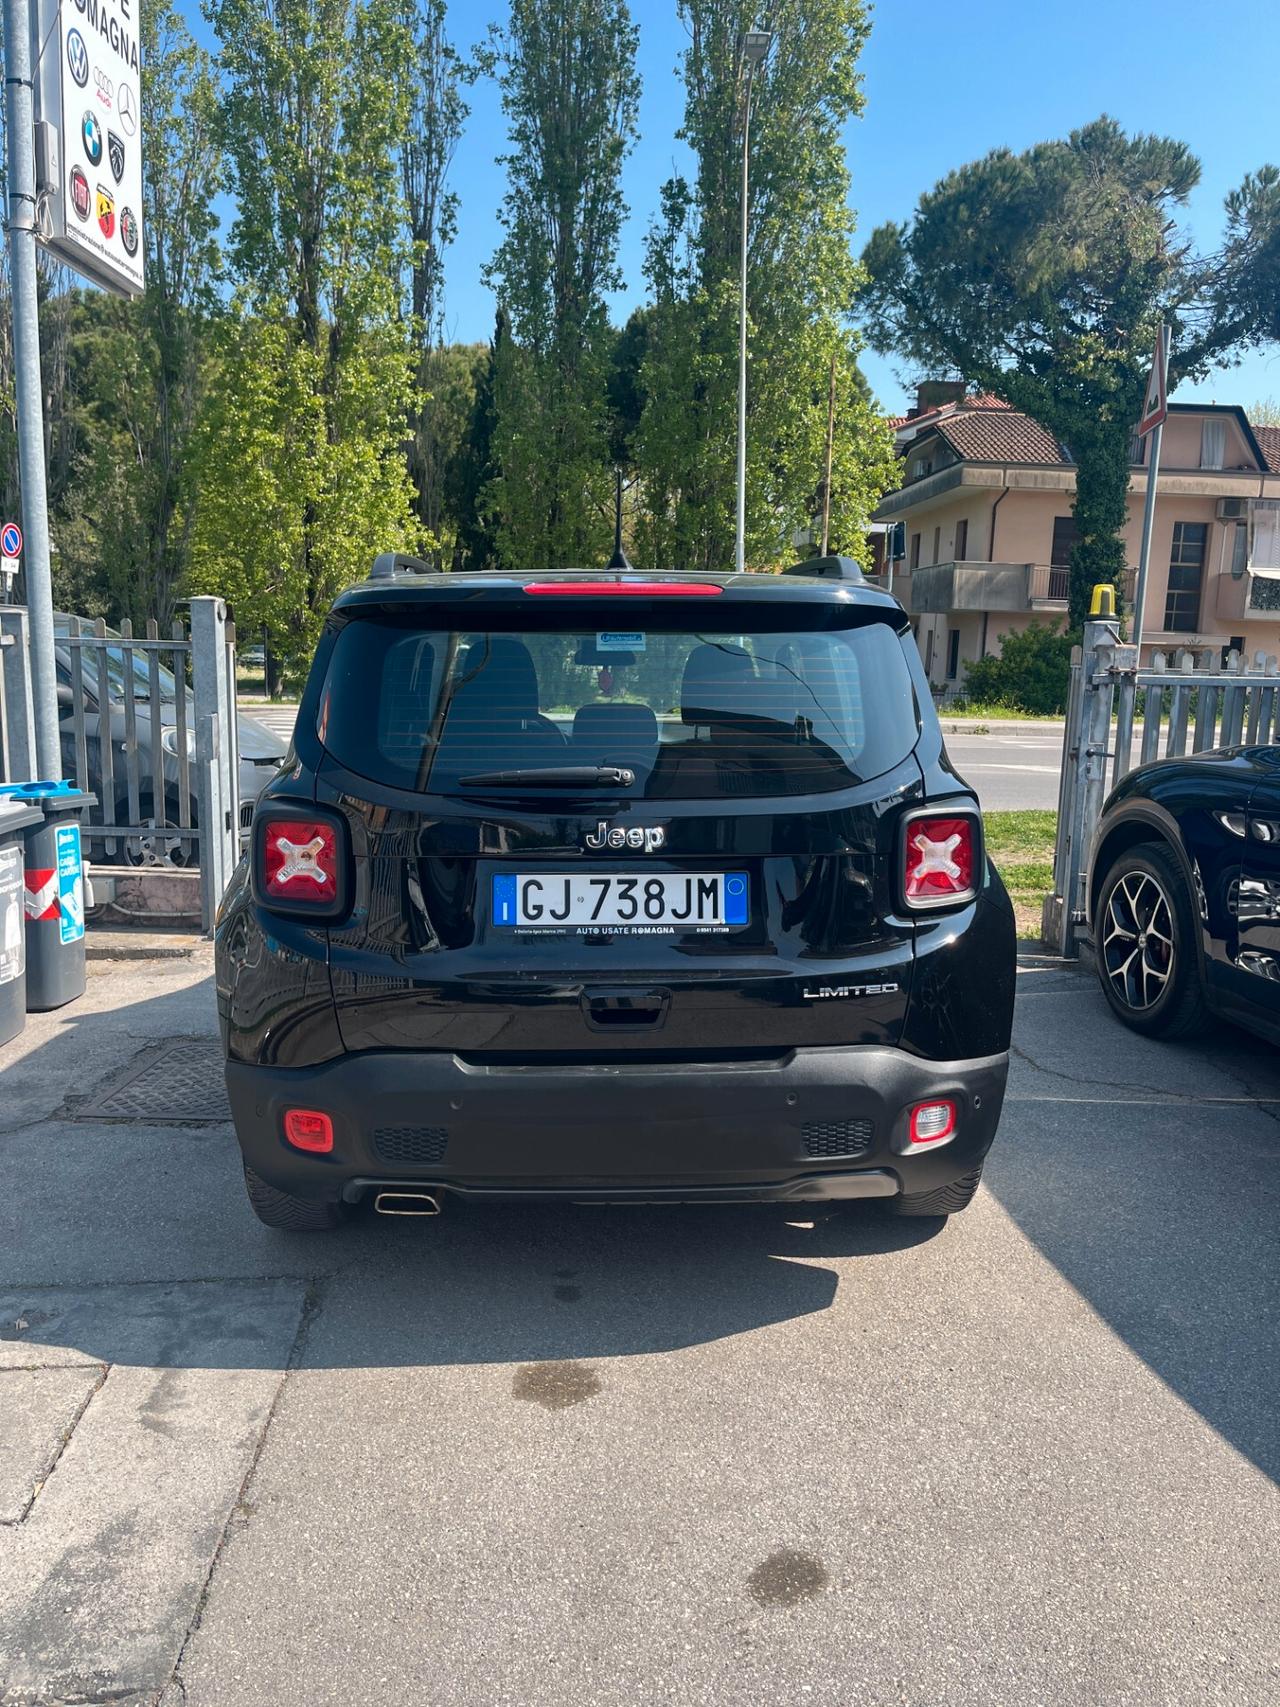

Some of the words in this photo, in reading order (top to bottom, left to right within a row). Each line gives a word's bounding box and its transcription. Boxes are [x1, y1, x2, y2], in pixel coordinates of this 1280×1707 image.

[586, 822, 665, 852] Jeep
[576, 927, 600, 935] AUTO
[602, 927, 629, 935] USATE
[631, 926, 675, 935] ROMAGNA
[803, 983, 899, 998] LIMITED
